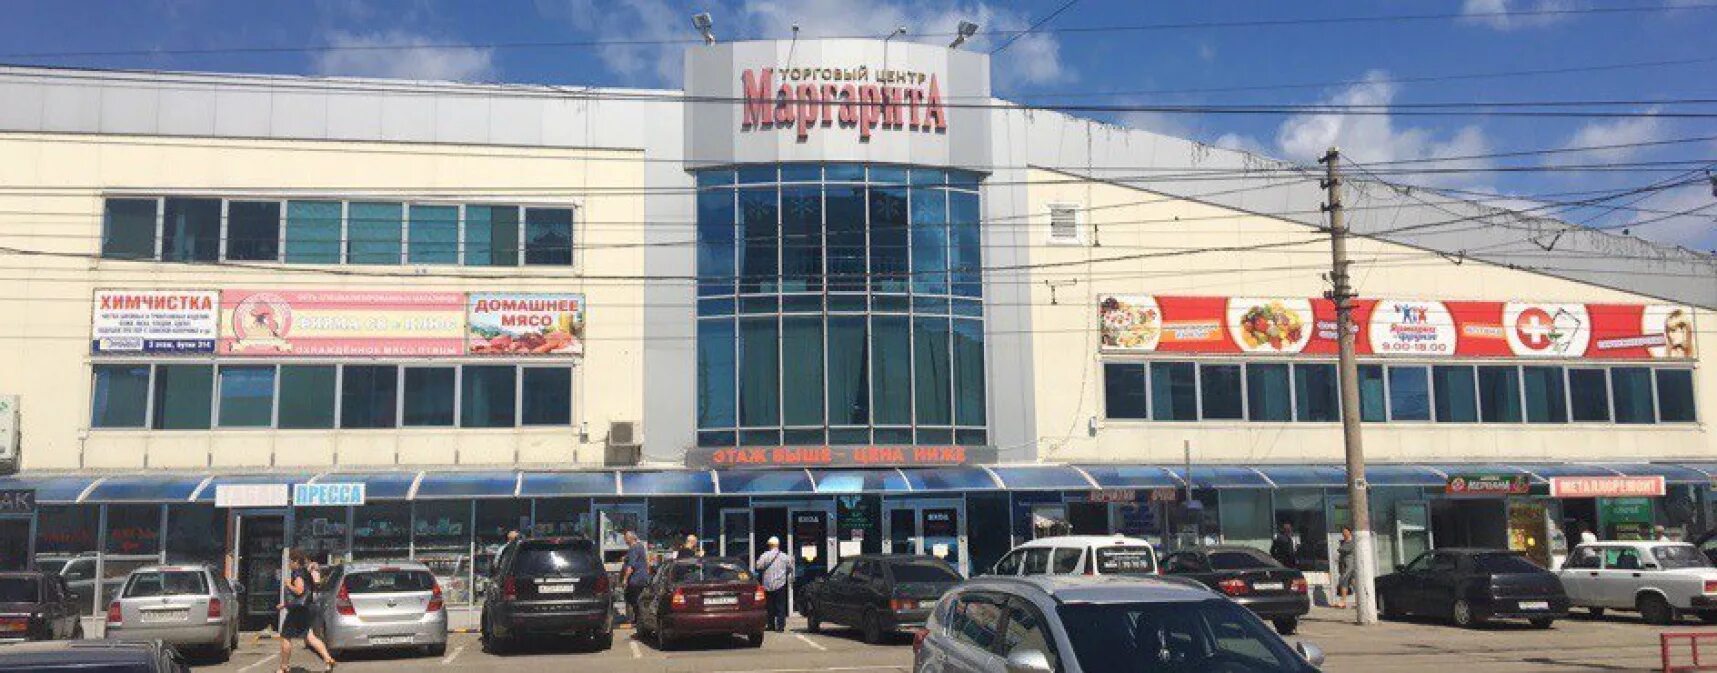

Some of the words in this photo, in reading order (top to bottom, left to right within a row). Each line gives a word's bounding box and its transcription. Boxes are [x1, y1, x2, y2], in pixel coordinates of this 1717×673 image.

[779, 65, 868, 81] ТОРГОВЫЙ
[875, 70, 926, 84] ЦЕНТР
[101, 295, 212, 310] ХИМЧИСТКА
[475, 299, 579, 313] ДОМАШНЕЕ
[502, 314, 553, 326] МЯСО
[713, 448, 767, 463] ЭТАЖ
[772, 447, 831, 463] ВЫШЕ
[854, 447, 904, 465] ЦЕНА
[914, 447, 966, 463] НИЖЕ
[1559, 479, 1656, 493] МЕТАЛЛОРЕМОНТ
[295, 485, 361, 504] ПРЕССА
